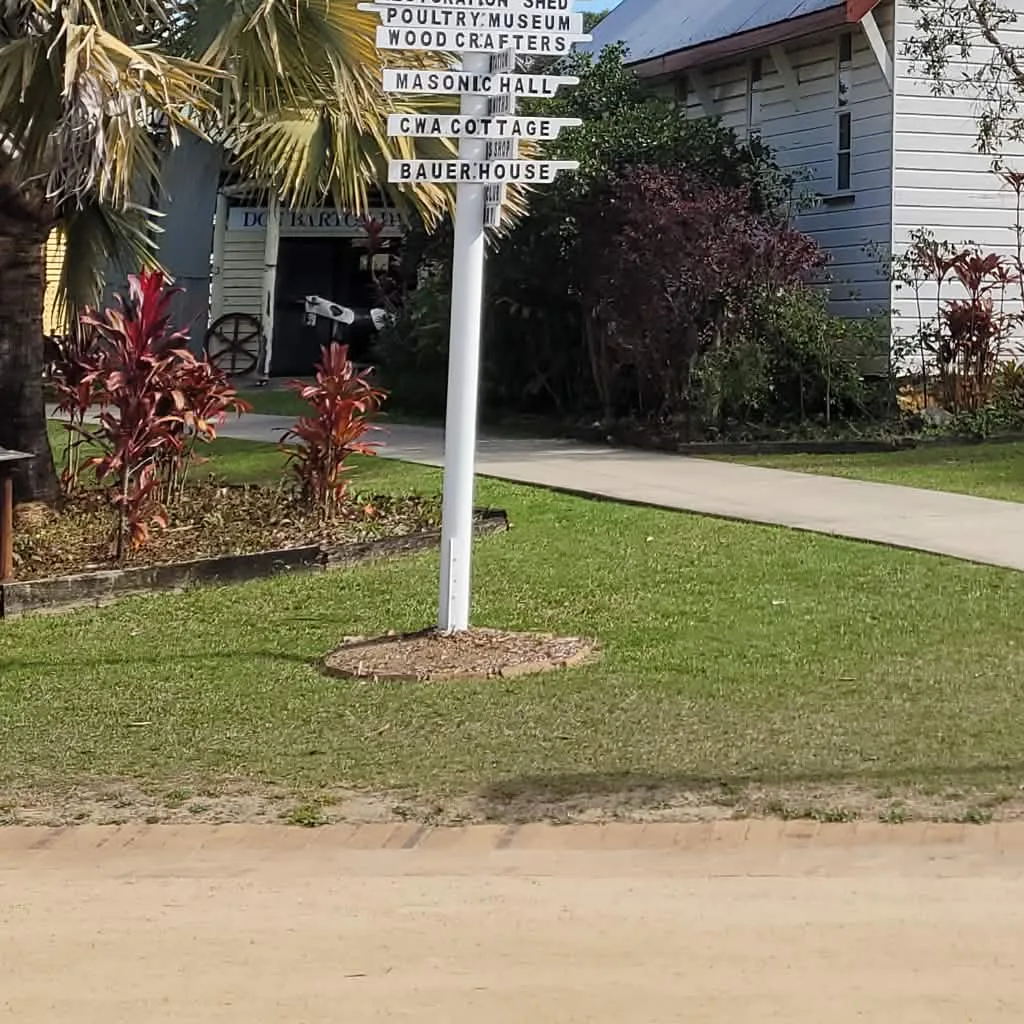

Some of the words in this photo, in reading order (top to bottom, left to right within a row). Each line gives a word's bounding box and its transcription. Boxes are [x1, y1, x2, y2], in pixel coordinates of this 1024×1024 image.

[386, 7, 481, 26] POULTRY
[488, 12, 571, 31] MUSEUM
[388, 29, 448, 47] WOOD
[455, 32, 566, 51] CRAFTERS
[396, 73, 492, 92] MASONIC
[500, 77, 552, 94] HALL
[451, 118, 550, 136] COTTAGE
[400, 162, 471, 180] BAUER
[479, 163, 550, 180] HOUSE
[243, 211, 284, 227] DO
